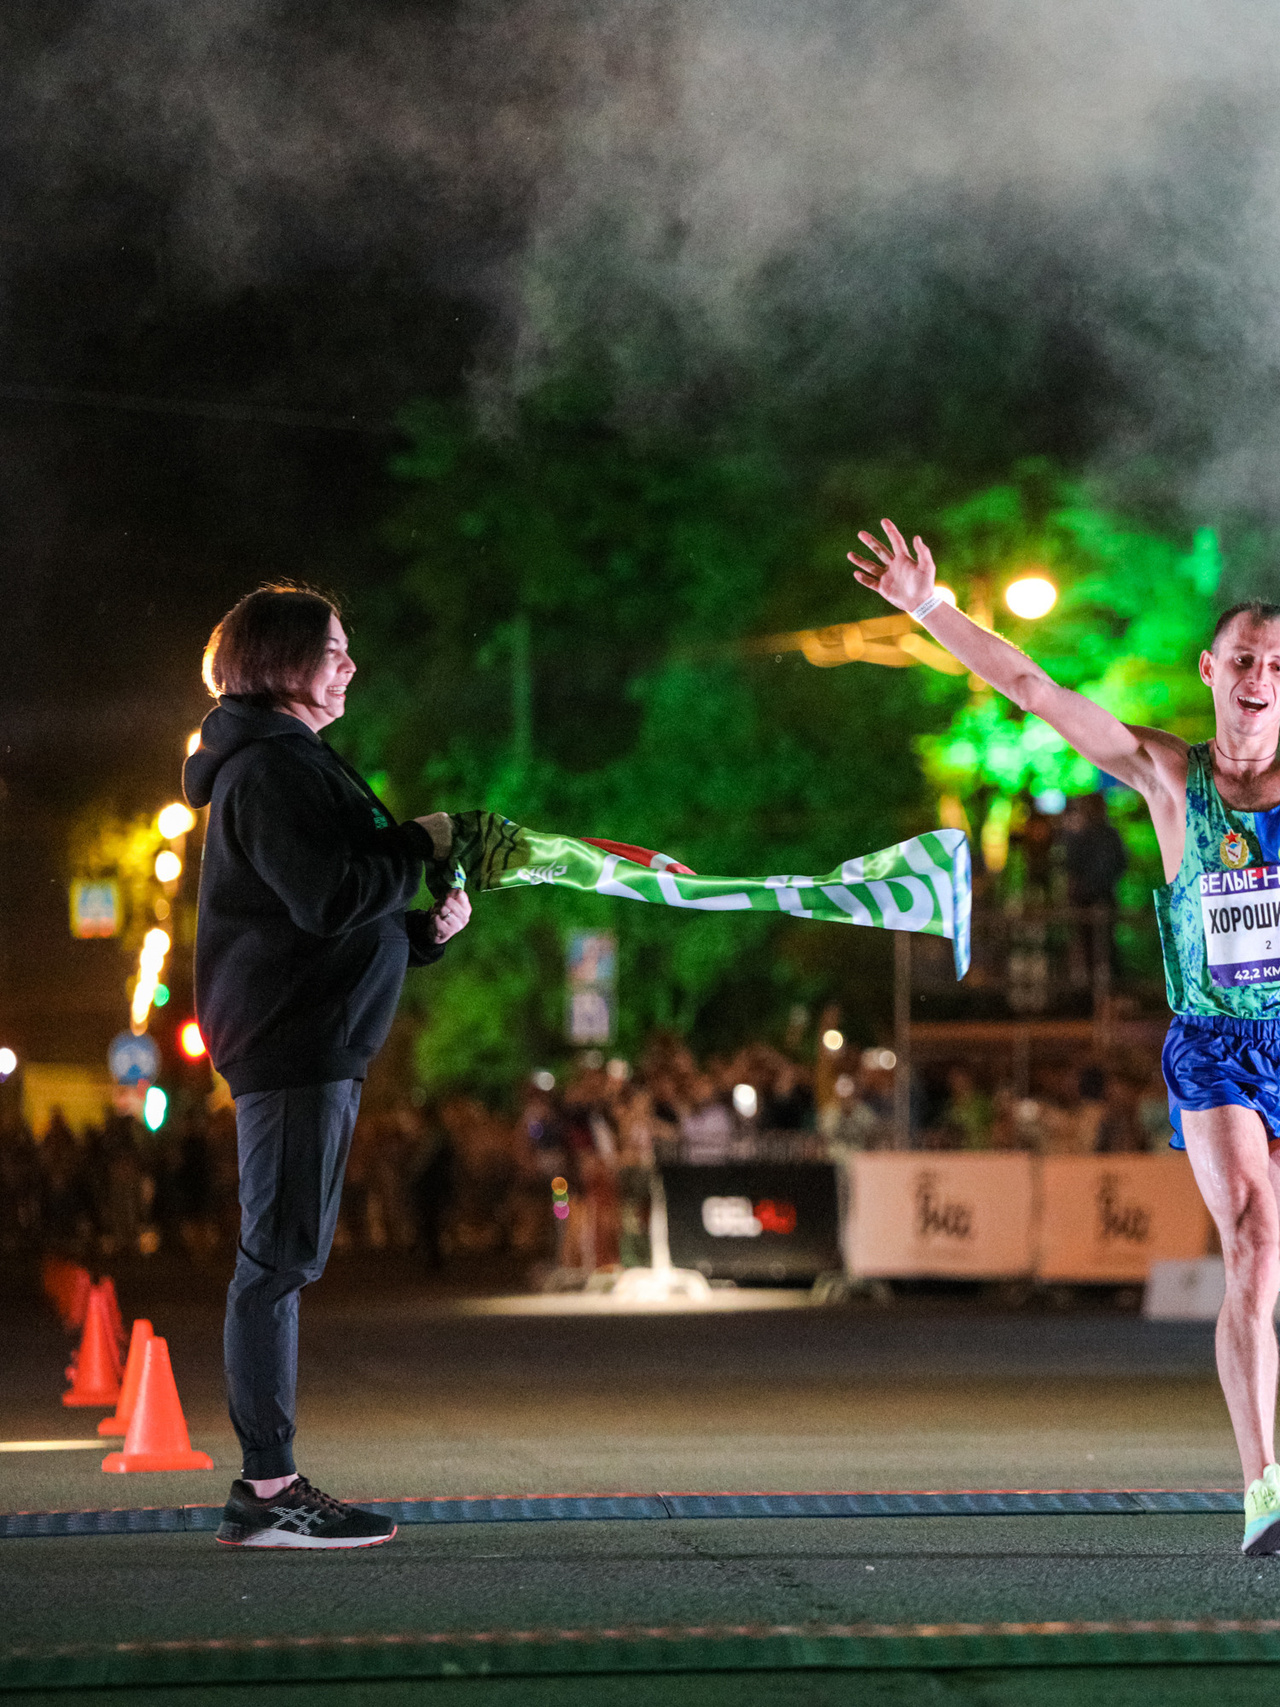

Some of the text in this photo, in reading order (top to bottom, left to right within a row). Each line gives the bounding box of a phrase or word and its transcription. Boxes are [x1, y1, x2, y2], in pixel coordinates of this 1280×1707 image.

[1200, 869, 1259, 894] БЕЛЫЕ
[1265, 940, 1272, 950] 2
[1234, 968, 1261, 981] 42,2
